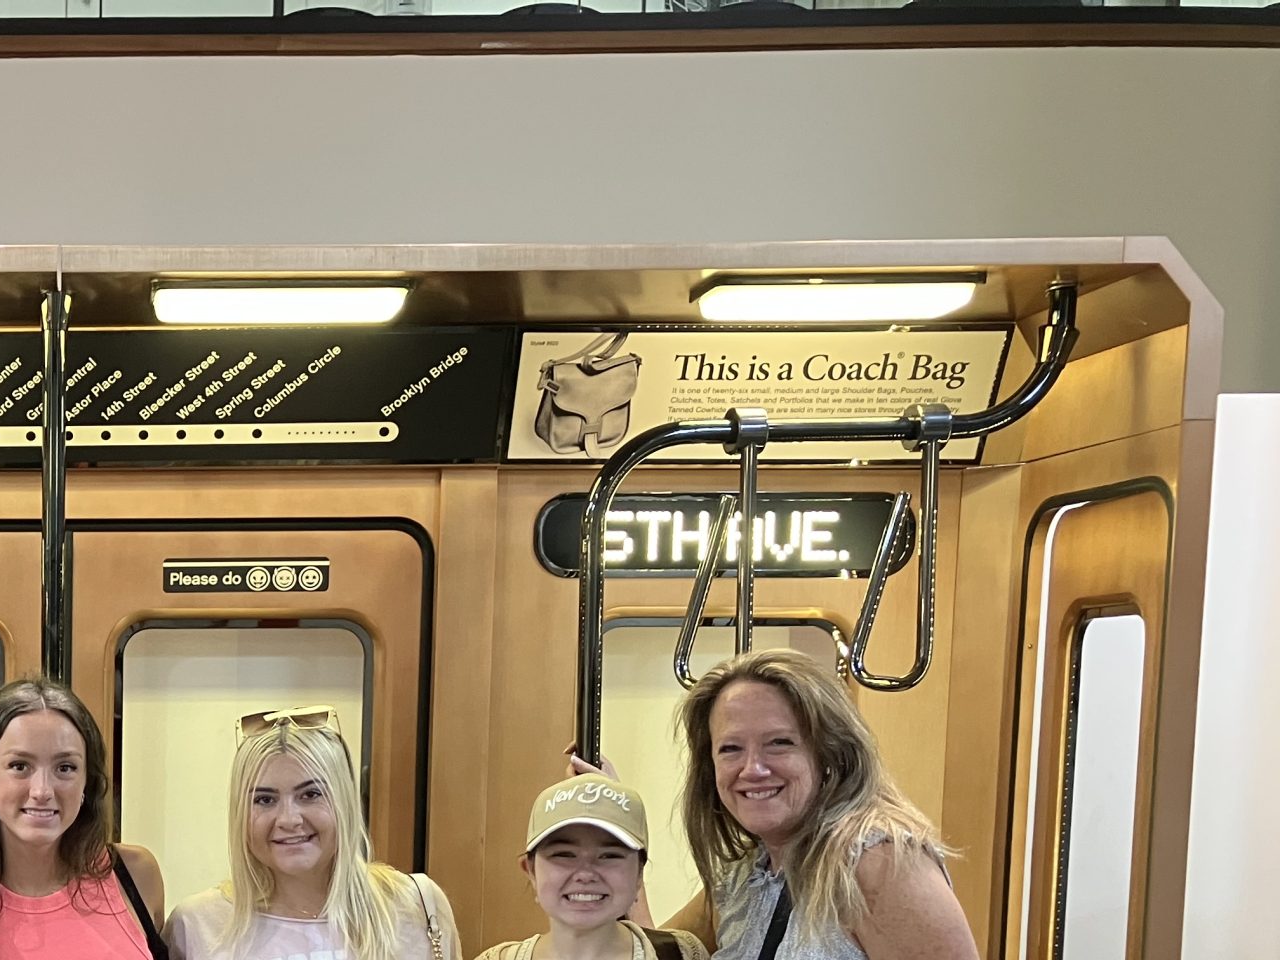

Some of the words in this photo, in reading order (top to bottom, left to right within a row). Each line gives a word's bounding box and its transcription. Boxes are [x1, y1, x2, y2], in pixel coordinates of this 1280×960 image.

[11, 371, 44, 401] Street
[65, 357, 97, 392] entral
[65, 394, 92, 421] Astor
[91, 370, 122, 397] Place
[139, 379, 186, 421] Bleecker
[184, 350, 220, 381] Street
[176, 394, 206, 420] West
[204, 380, 224, 397] 4th
[222, 351, 257, 382] Street
[215, 387, 254, 419] Spring
[250, 359, 286, 390] Street
[254, 372, 308, 418] Columbus
[307, 346, 341, 374] Circle
[380, 377, 431, 417] Brooklyn
[429, 347, 468, 378] Bridge
[674, 353, 740, 381] This
[745, 355, 770, 381] is
[777, 362, 793, 381] a
[907, 353, 970, 389] Bag
[712, 387, 748, 395] twenty-six
[821, 387, 840, 395] large
[101, 400, 125, 421] 14th
[122, 372, 157, 402] Street
[170, 571, 218, 586] Please
[222, 571, 242, 585] do
[545, 785, 579, 812] New
[578, 782, 632, 812] York
